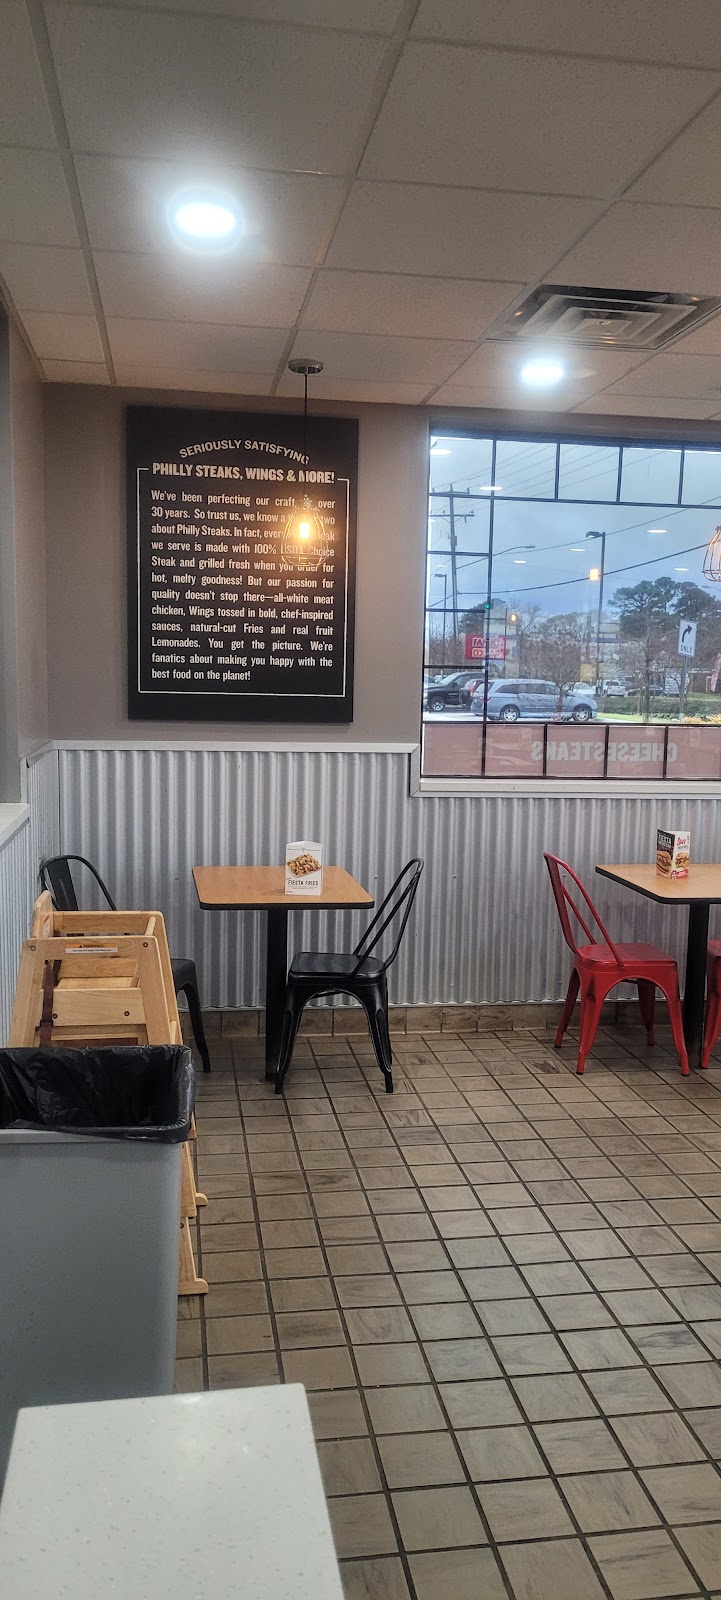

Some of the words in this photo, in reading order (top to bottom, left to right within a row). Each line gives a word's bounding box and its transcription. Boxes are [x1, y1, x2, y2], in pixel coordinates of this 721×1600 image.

[179, 440, 241, 458] SERIOUSLY
[244, 440, 310, 465] SATISFYING
[152, 463, 193, 476] PHILLY
[195, 465, 243, 480] STEAKS,
[245, 468, 284, 481] WINGS
[286, 470, 296, 482] &
[298, 470, 334, 484] MORE!
[151, 490, 176, 501] We've
[182, 491, 202, 502] been
[208, 494, 251, 507] perfecting
[256, 498, 270, 506] our
[318, 500, 336, 508] over
[151, 506, 163, 517] 30
[165, 509, 190, 519] years.
[194, 508, 205, 519] So
[207, 510, 228, 520] trust
[230, 512, 242, 522] us,
[243, 512, 255, 522] we
[257, 512, 278, 523] know
[280, 515, 286, 523] a
[321, 515, 336, 525] two
[151, 523, 176, 534] about
[177, 524, 200, 537] Philly
[202, 525, 232, 536] Steaks.
[234, 527, 242, 537] In
[244, 527, 262, 539] fact,
[151, 542, 164, 550] we
[167, 542, 190, 551] serve
[194, 542, 202, 551] is
[206, 542, 228, 552] made
[232, 543, 250, 554] with
[254, 544, 276, 554] 100%
[152, 556, 176, 567] Steak
[180, 558, 196, 568] and
[199, 558, 224, 570] grilled
[228, 559, 250, 569] fresh
[254, 560, 276, 571] when
[279, 563, 294, 572] you
[322, 563, 334, 572] for
[152, 572, 168, 583] hot,
[173, 574, 196, 586] melty
[202, 575, 242, 586] goodness!
[248, 576, 262, 586] But
[286, 578, 317, 589] passion
[322, 578, 334, 588] for
[152, 589, 180, 601] quality
[185, 590, 216, 600] doesn't
[220, 592, 238, 603] stop
[314, 595, 334, 604] meat
[152, 605, 186, 616] chicken,
[189, 606, 214, 618] Wings
[218, 607, 244, 618] tossed
[248, 608, 256, 618] in
[259, 608, 278, 619] bold,
[280, 609, 334, 621] chef-inspired
[152, 623, 183, 632] sauces,
[190, 622, 236, 633] natural-cut
[244, 623, 264, 634] Fries
[270, 625, 286, 635] and
[293, 625, 308, 635] real
[316, 626, 334, 636] fruit
[152, 637, 200, 648] Lemonades.
[208, 638, 224, 648] You
[231, 640, 244, 650] get
[252, 640, 265, 650] the
[272, 640, 303, 651] picture.
[310, 641, 334, 651] We're
[680, 644, 692, 654] ONLY
[152, 652, 186, 663] fanatics
[190, 654, 213, 664] about
[218, 654, 247, 666] making
[251, 656, 266, 666] you
[270, 656, 294, 668] happy
[298, 657, 316, 667] with
[320, 657, 333, 667] the
[152, 668, 170, 678] best
[173, 669, 191, 679] food
[194, 671, 204, 680] on
[207, 670, 220, 680] the
[223, 670, 250, 682] planet!
